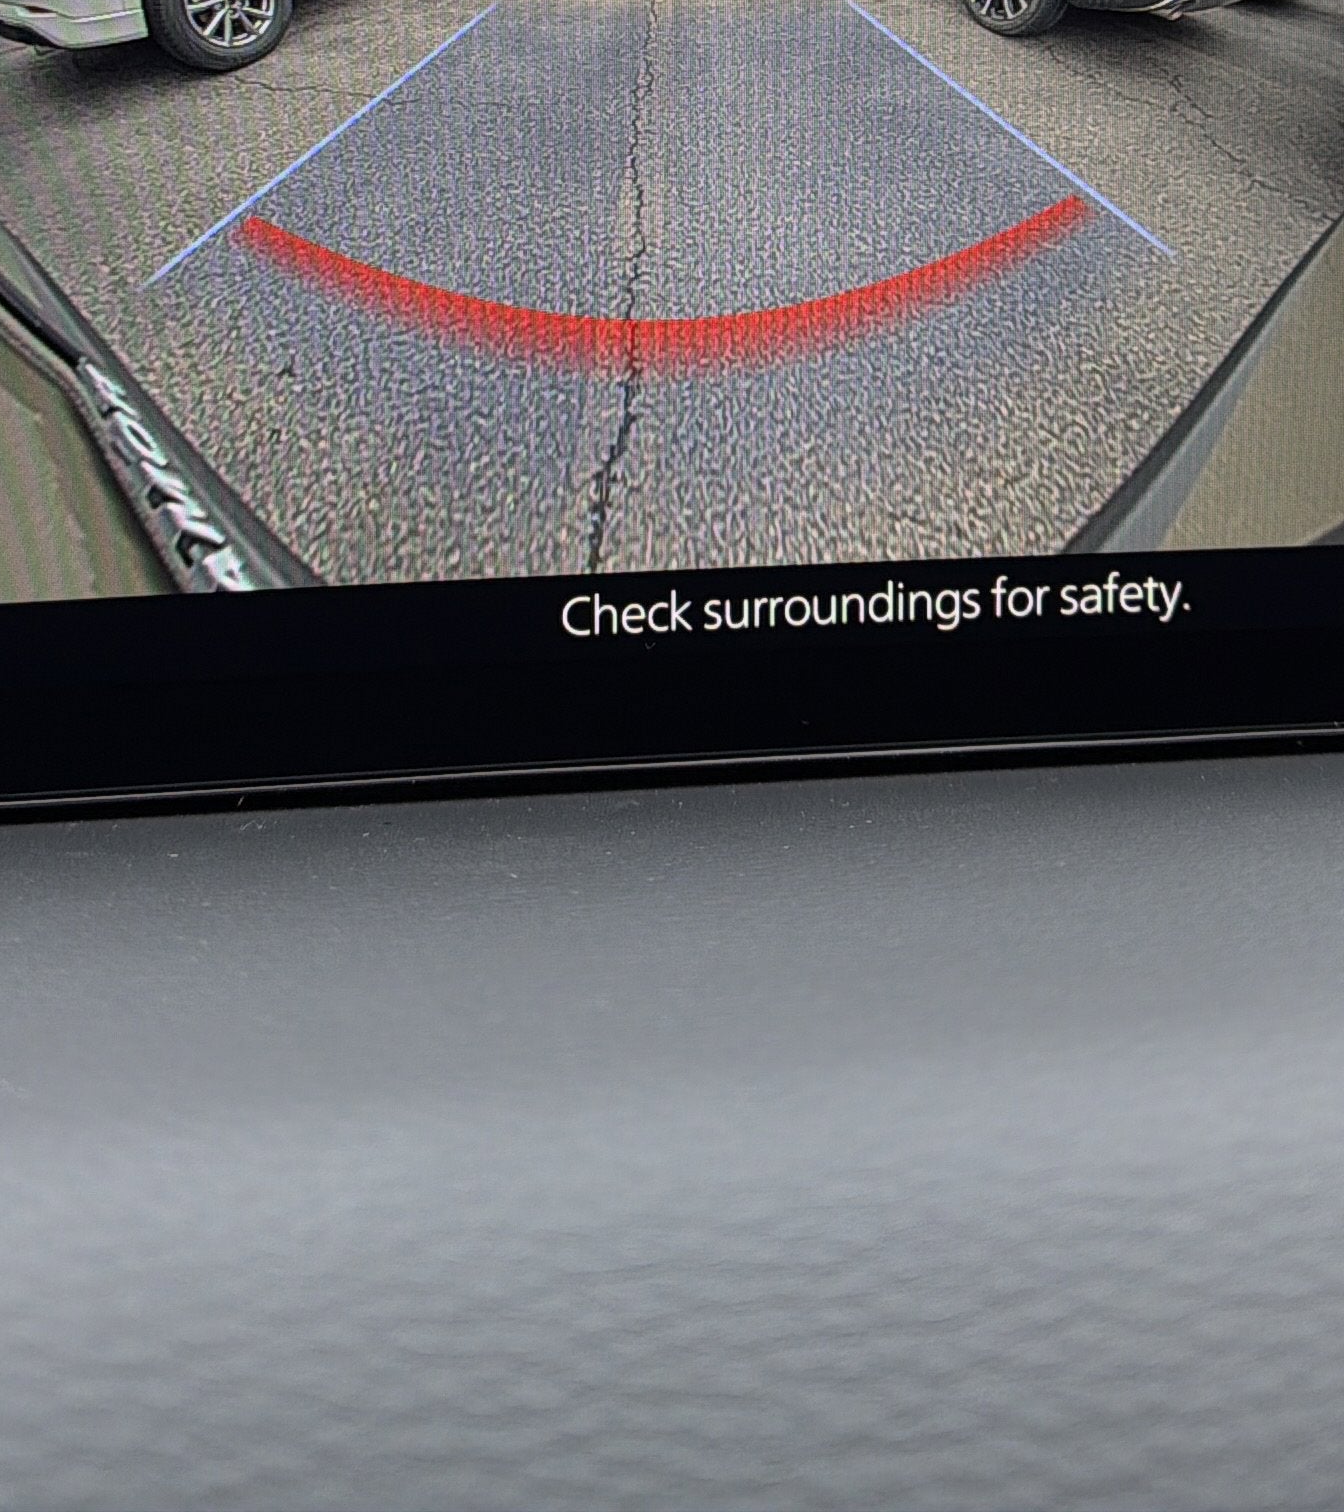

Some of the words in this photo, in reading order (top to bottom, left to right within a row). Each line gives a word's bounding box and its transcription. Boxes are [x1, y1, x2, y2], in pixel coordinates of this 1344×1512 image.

[561, 590, 693, 637] Check
[702, 580, 981, 630] surroundings
[990, 575, 1051, 619] for
[1059, 571, 1191, 622] safety.
